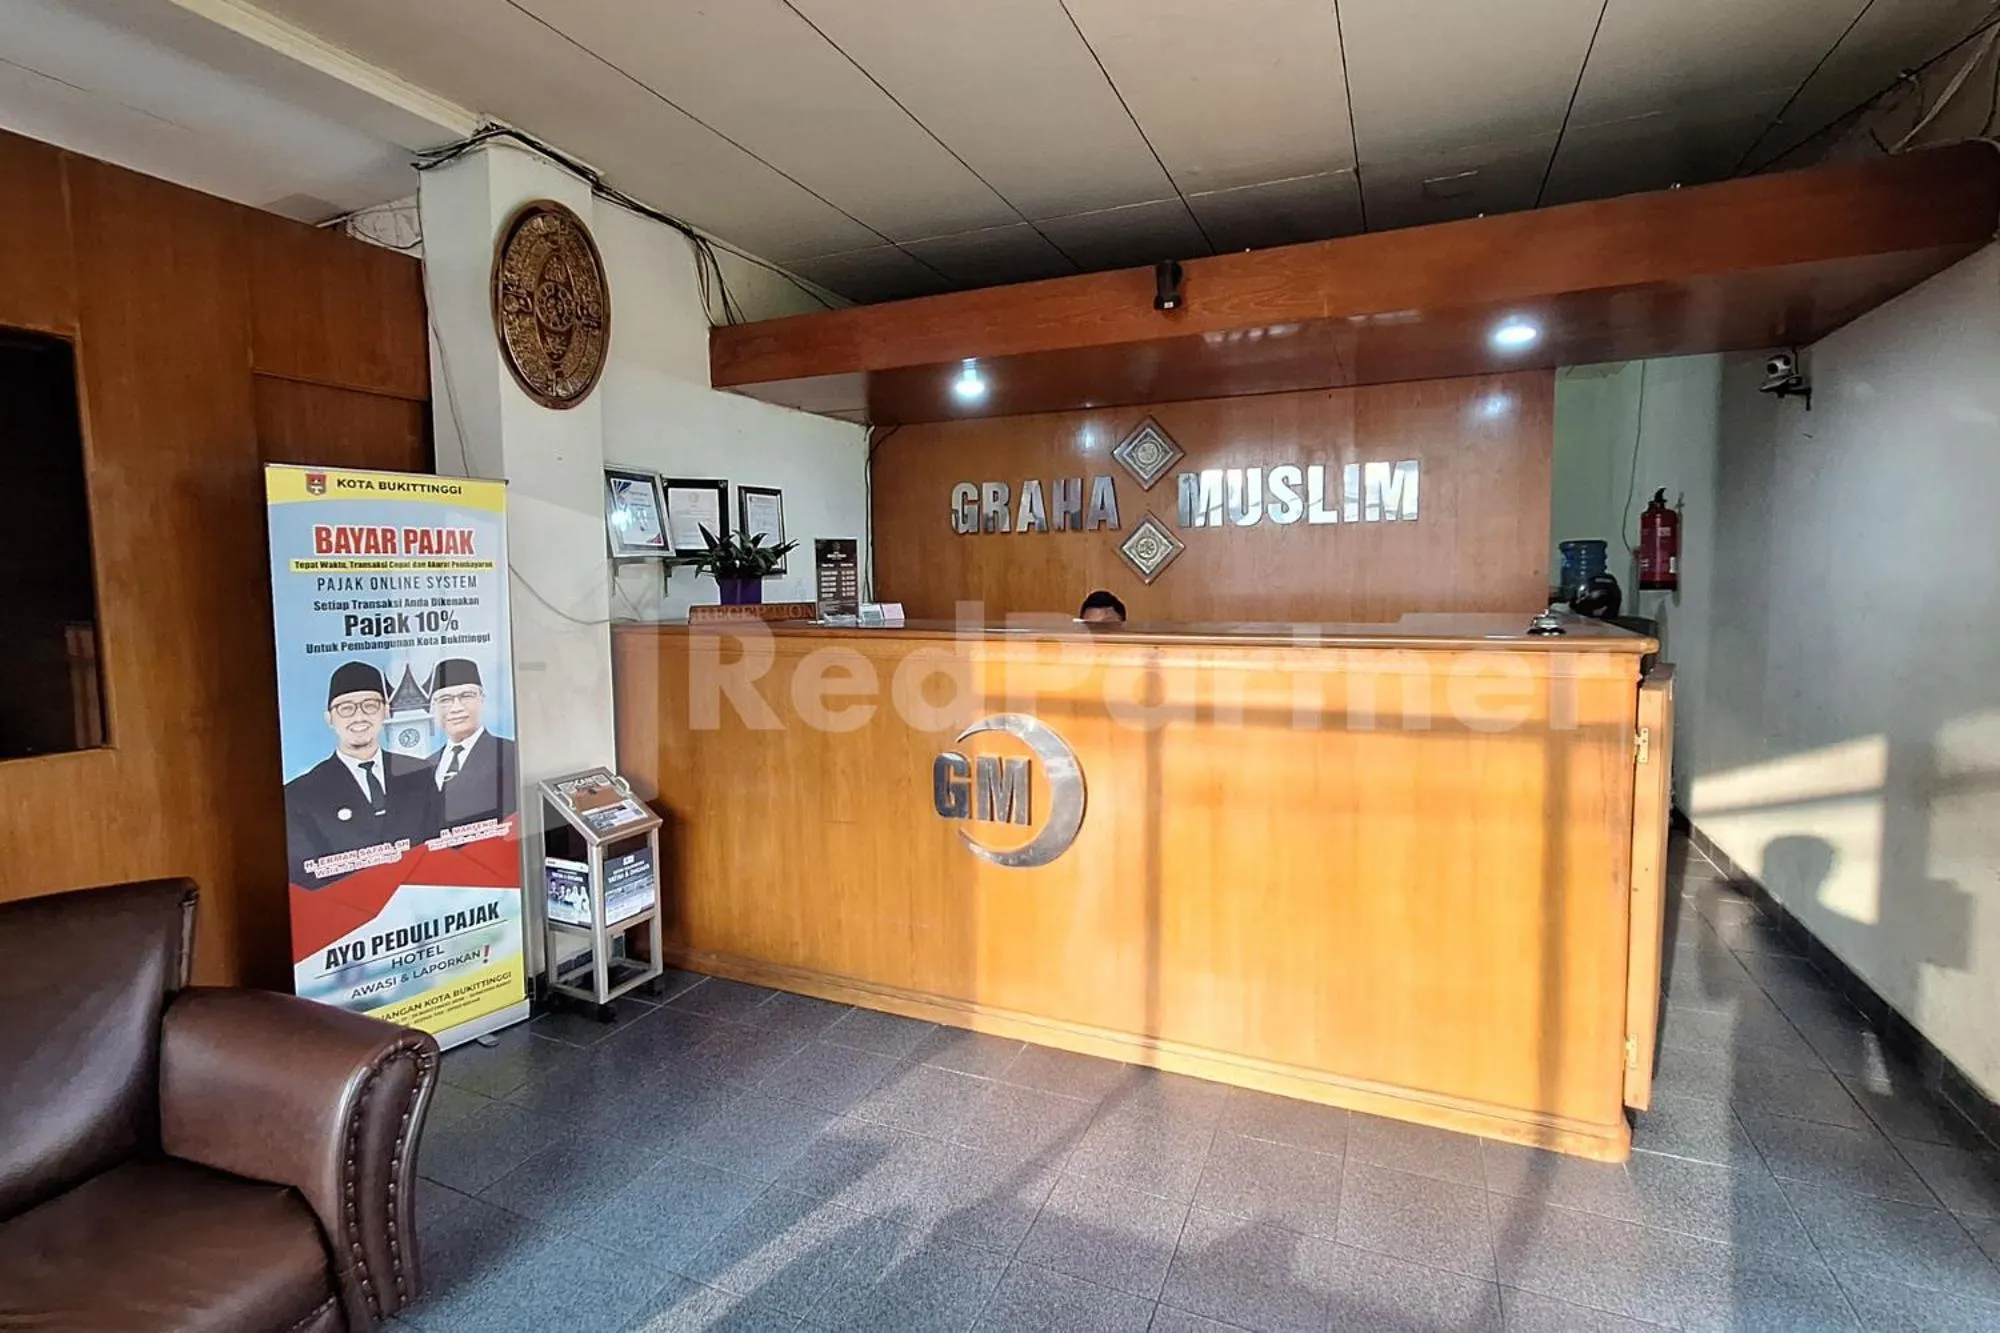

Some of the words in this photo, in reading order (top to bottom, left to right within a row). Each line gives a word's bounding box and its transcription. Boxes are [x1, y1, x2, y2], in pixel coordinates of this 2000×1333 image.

[336, 478, 375, 491] KOTA
[378, 480, 463, 495] BUKITTINGGI
[951, 475, 1120, 535] GRAHA
[1177, 460, 1420, 529] MUSLIM
[314, 526, 397, 555] BAYAR
[403, 528, 475, 556] PAJAK
[295, 561, 319, 570] Tepat
[349, 561, 388, 569] Transaksi
[317, 577, 364, 591] PAJAK
[370, 576, 421, 590] ONLINE
[426, 575, 477, 589] SYSTEM
[313, 600, 350, 612] Setiap
[352, 599, 401, 610] Transaksi
[404, 598, 429, 608] Anda
[431, 597, 480, 608] Dikenakan
[344, 613, 411, 637] Pajak
[415, 610, 459, 632] 10%
[305, 643, 338, 654] Untuk
[341, 639, 415, 652] Pembangunan
[416, 636, 439, 647] Kota
[440, 633, 491, 646] Bukittinggi
[932, 751, 1033, 826] GM
[325, 941, 366, 970] AYO
[371, 925, 440, 957] PEDULI
[444, 901, 501, 934] PAJAK
[391, 944, 445, 969] HOTEL
[351, 977, 398, 999] AWASI
[401, 973, 409, 984] &
[424, 993, 452, 1006] KOTA
[453, 971, 512, 997] BUKITTINGGI
